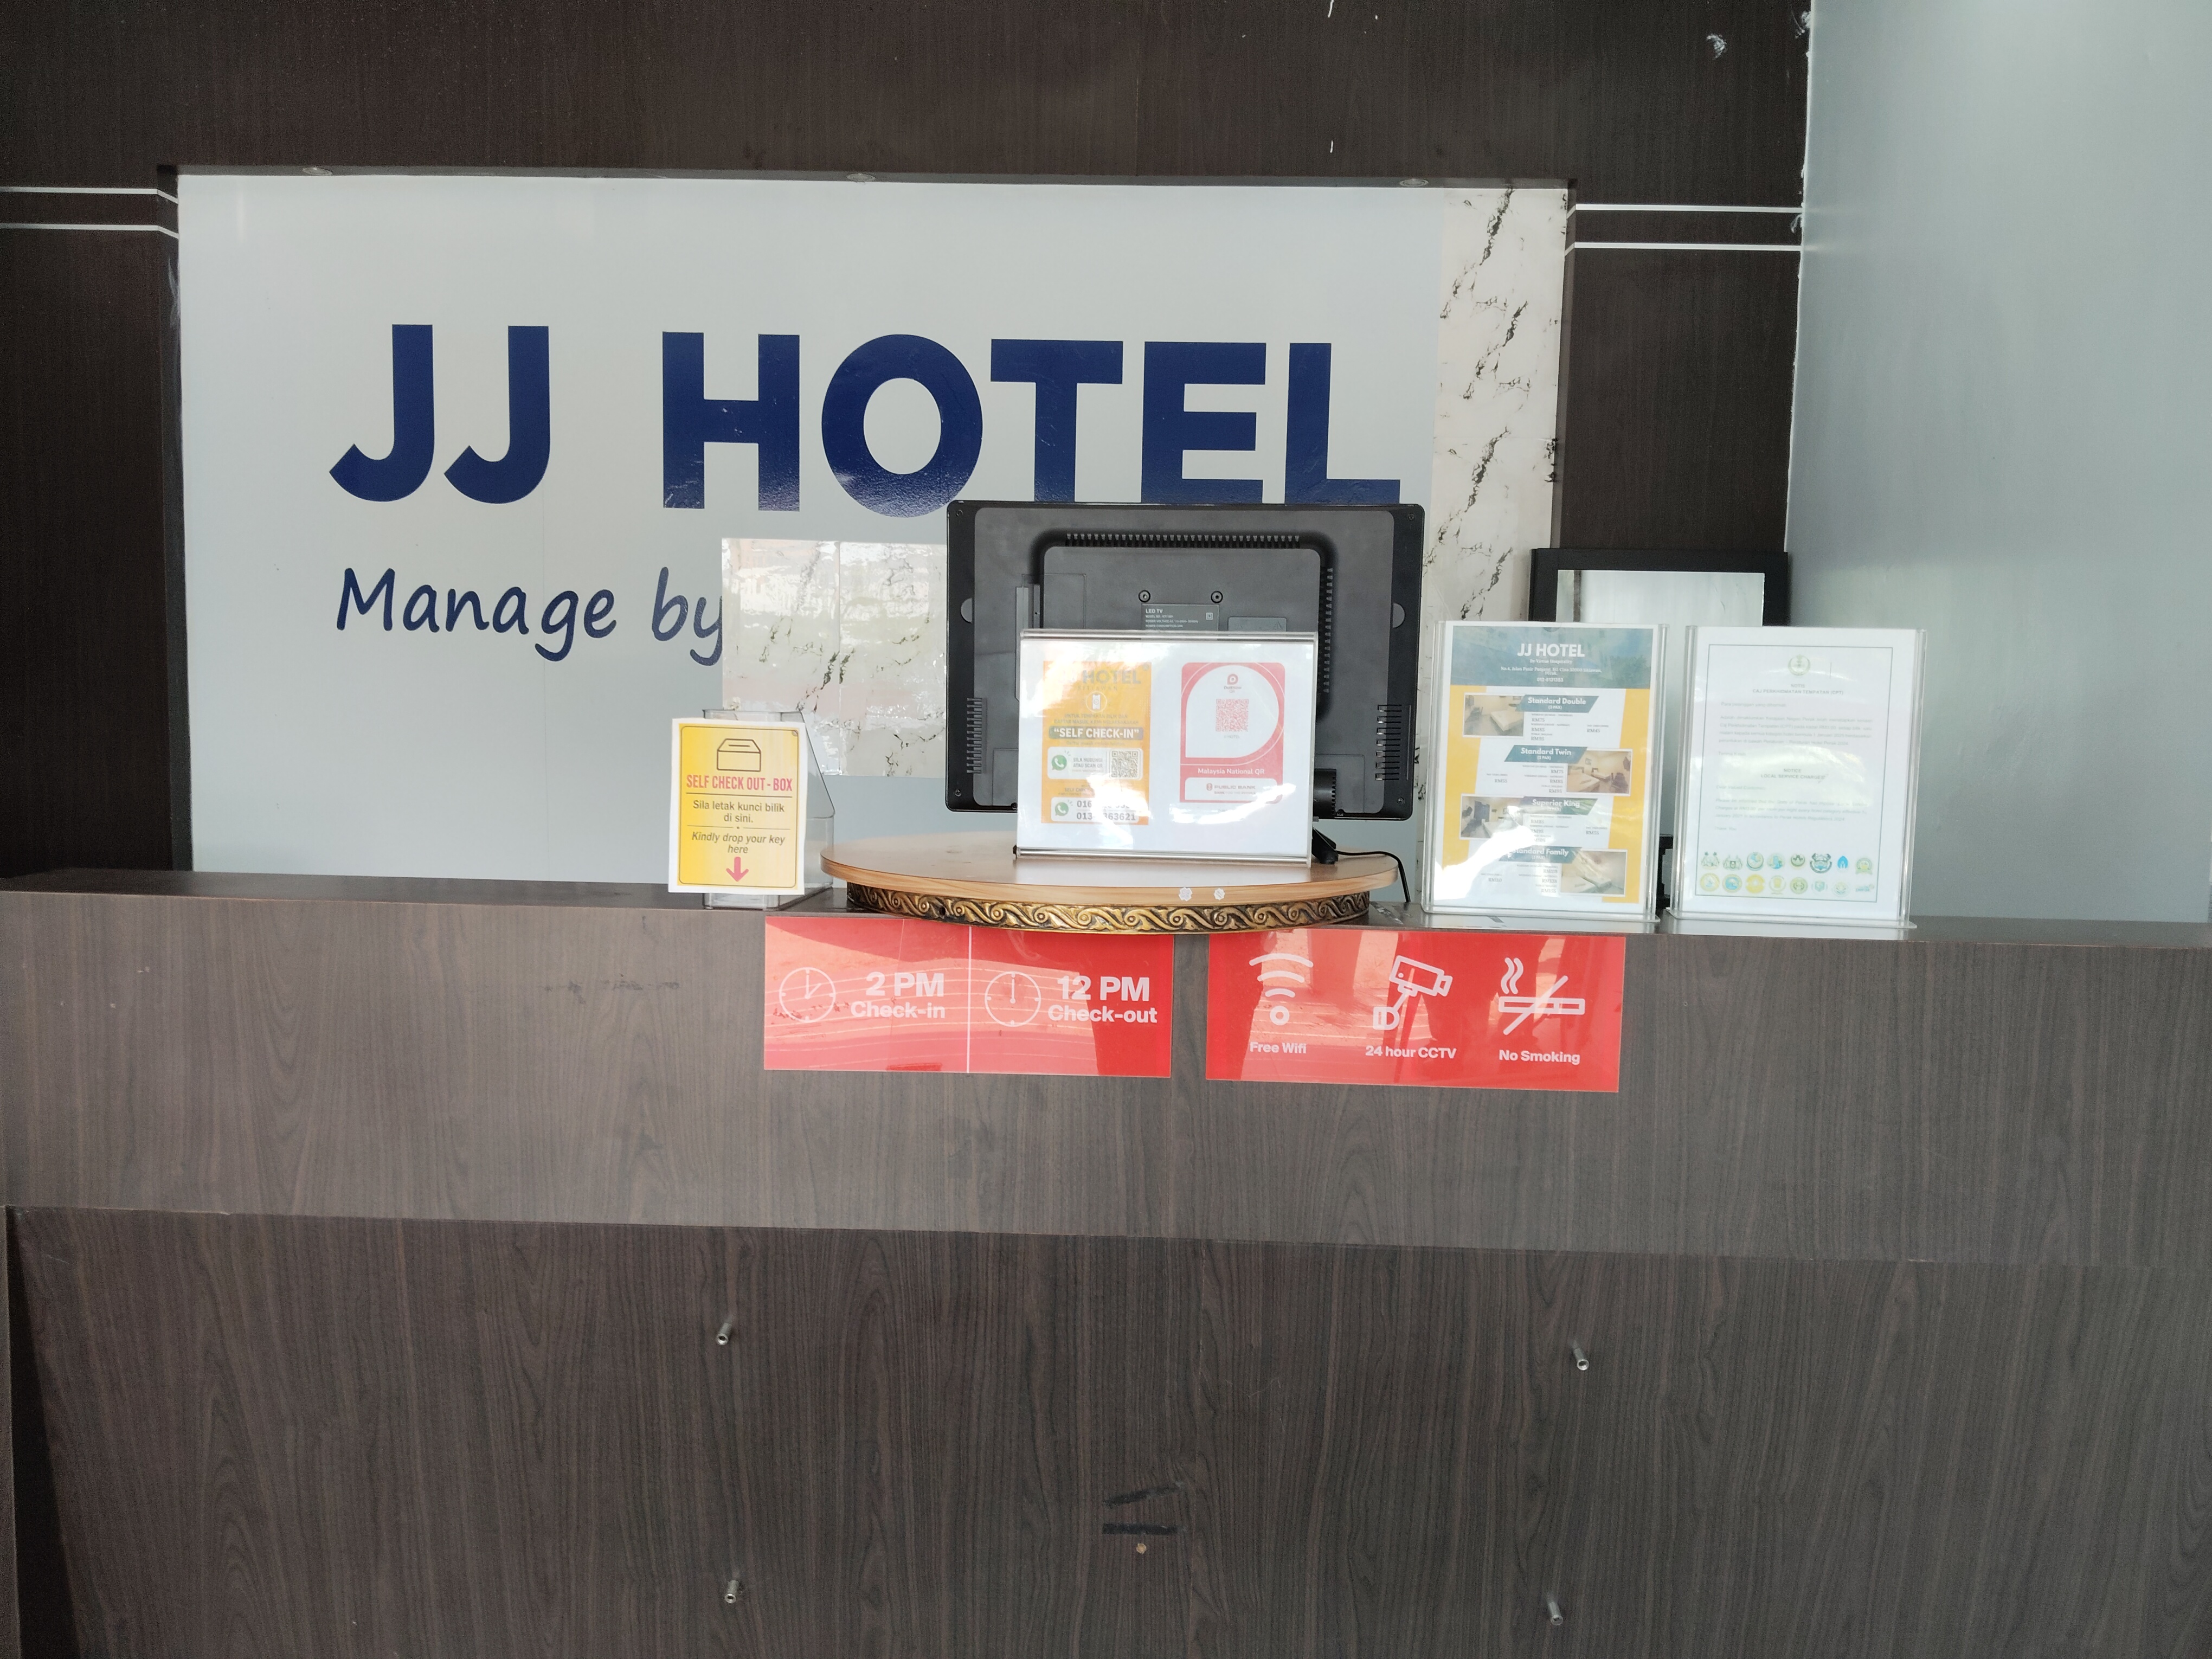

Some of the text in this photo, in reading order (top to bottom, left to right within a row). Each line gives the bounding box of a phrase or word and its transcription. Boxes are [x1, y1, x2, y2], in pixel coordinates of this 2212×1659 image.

[329, 324, 1400, 518] JJ HOTEL
[336, 567, 723, 666] Manage by
[1517, 644, 1585, 657] JJ HOTEL
[686, 774, 709, 788] SELF
[712, 776, 744, 790] CHECK
[747, 777, 766, 790] OUT
[773, 777, 793, 792] BOX
[693, 800, 785, 812] Sila letak kunci bilik
[1532, 799, 1580, 808] Superior King
[724, 813, 754, 823] di sini.
[692, 832, 786, 846] Kindly drop your key
[727, 845, 749, 854] here
[1546, 848, 1570, 857] Family
[866, 973, 944, 998] 2 PM
[1057, 975, 1150, 1002] 12 PM
[850, 1000, 946, 1020] Check-in
[1047, 1005, 1157, 1024] Check-out
[1250, 1042, 1307, 1054] Free Wifi
[1366, 1046, 1457, 1059] 24 hour CCTV
[1499, 1050, 1580, 1065] No Smoking
